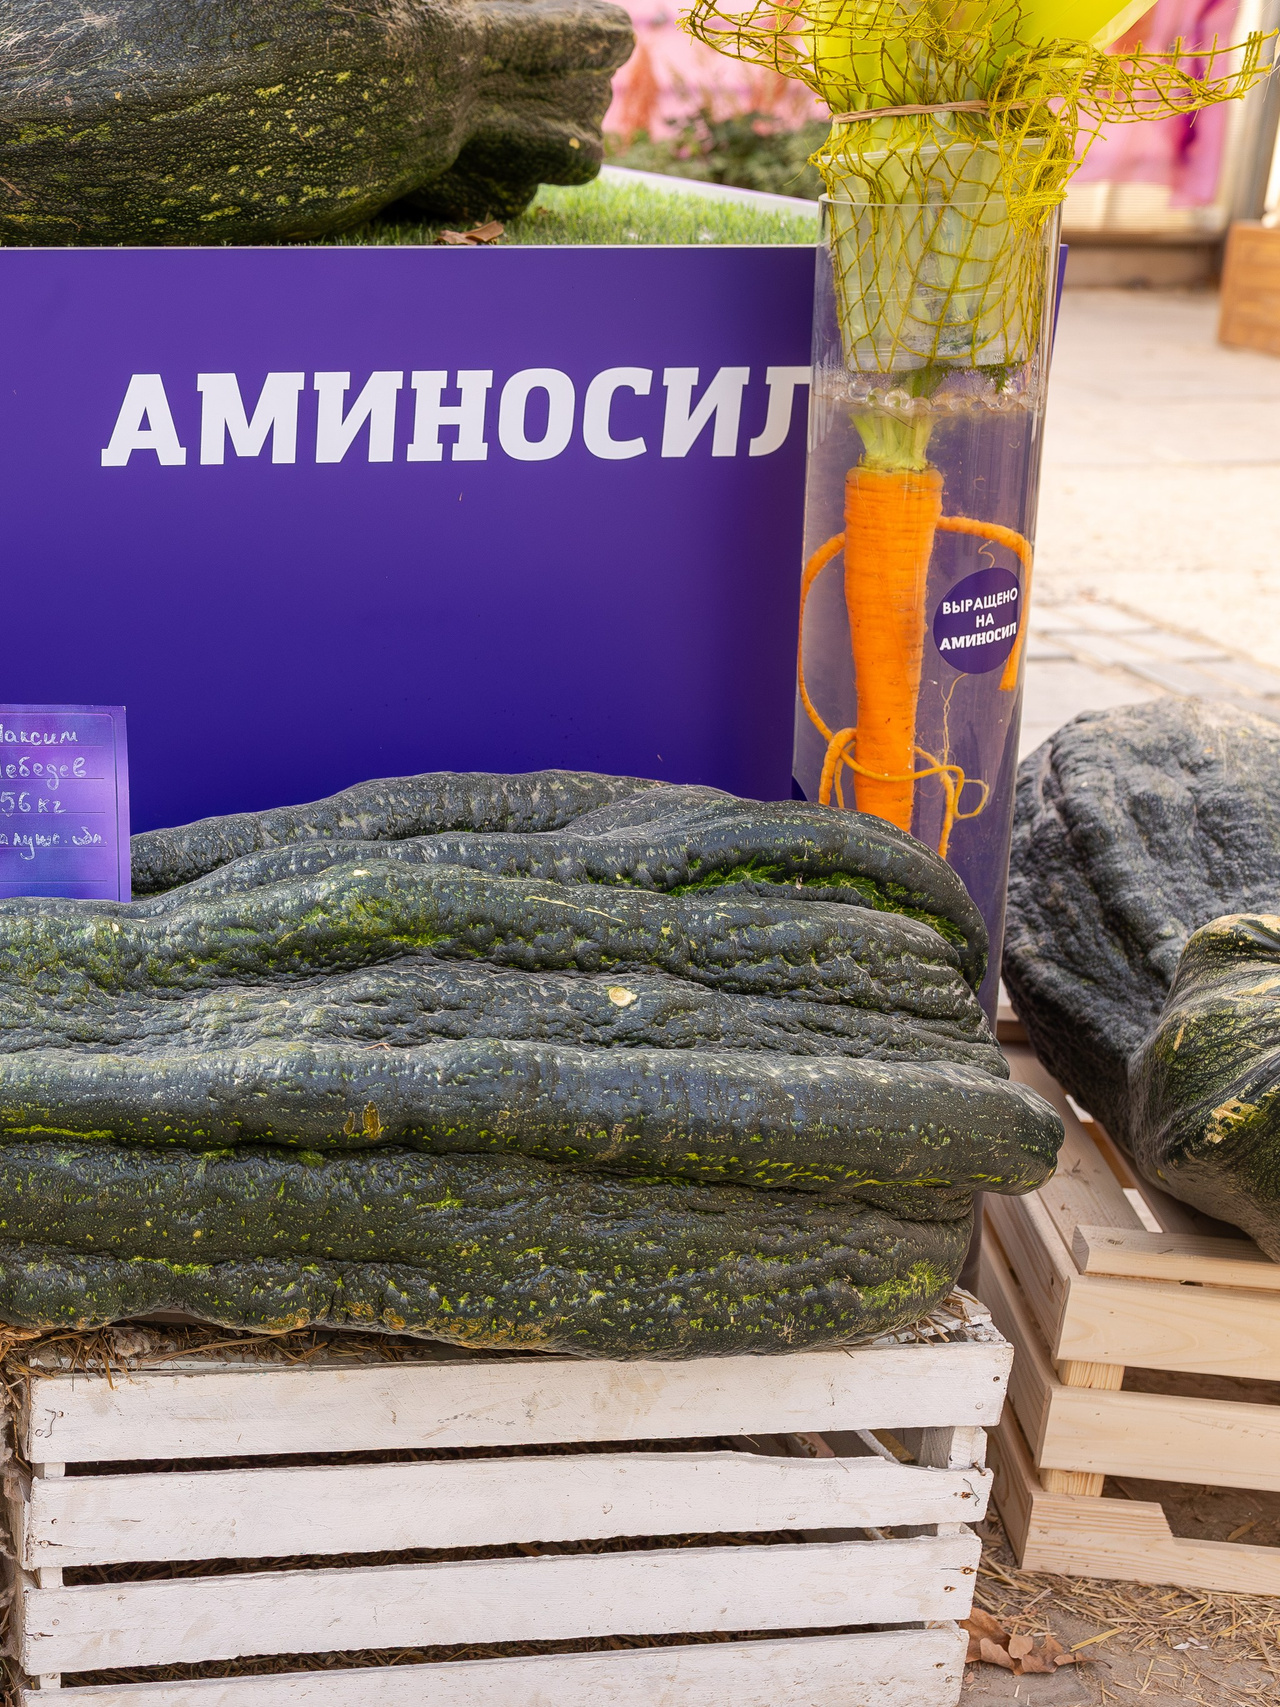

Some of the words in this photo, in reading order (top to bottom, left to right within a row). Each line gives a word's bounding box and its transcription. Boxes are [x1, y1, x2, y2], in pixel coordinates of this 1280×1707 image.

[942, 587, 1018, 615] ВЫРАЩЕНО
[975, 612, 995, 628] НА
[939, 621, 1017, 651] АМИНОСИЛ
[0, 791, 31, 817] 56
[38, 798, 66, 813] кг
